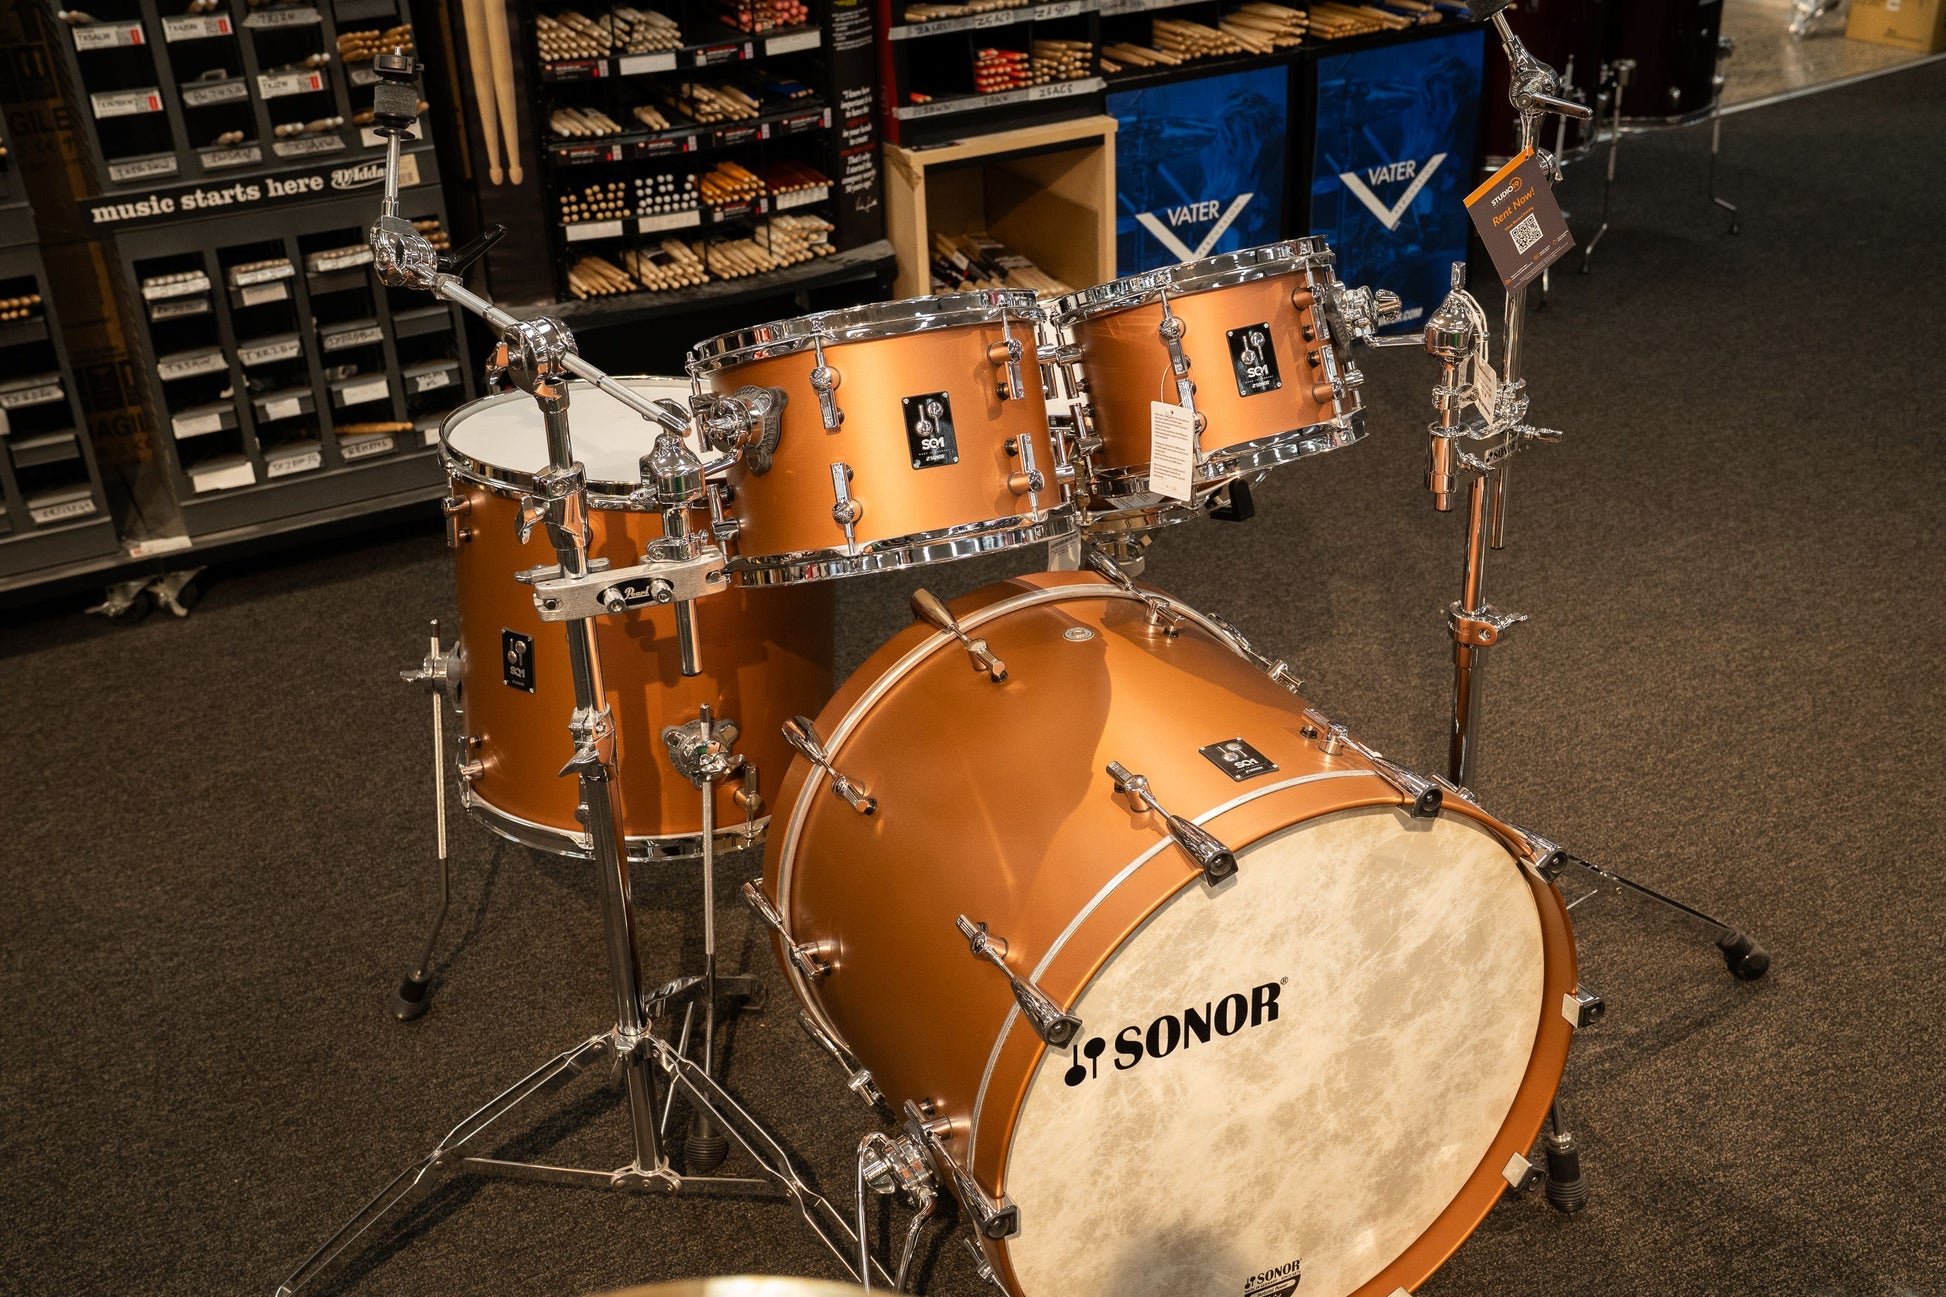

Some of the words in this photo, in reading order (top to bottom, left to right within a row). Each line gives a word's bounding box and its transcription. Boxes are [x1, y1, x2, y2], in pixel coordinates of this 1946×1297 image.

[1368, 160, 1417, 186] VATER
[91, 196, 175, 223] music
[181, 181, 261, 211] starts
[267, 173, 324, 198] here
[1492, 206, 1513, 227] Rent
[1513, 186, 1536, 211] Now!
[1167, 200, 1220, 227] VATER
[1247, 363, 1269, 378] SQ1
[921, 436, 945, 450] SQ1
[624, 586, 650, 600] Pearl
[1113, 981, 1281, 1071] SONOR
[1257, 1259, 1300, 1285] SONOR
